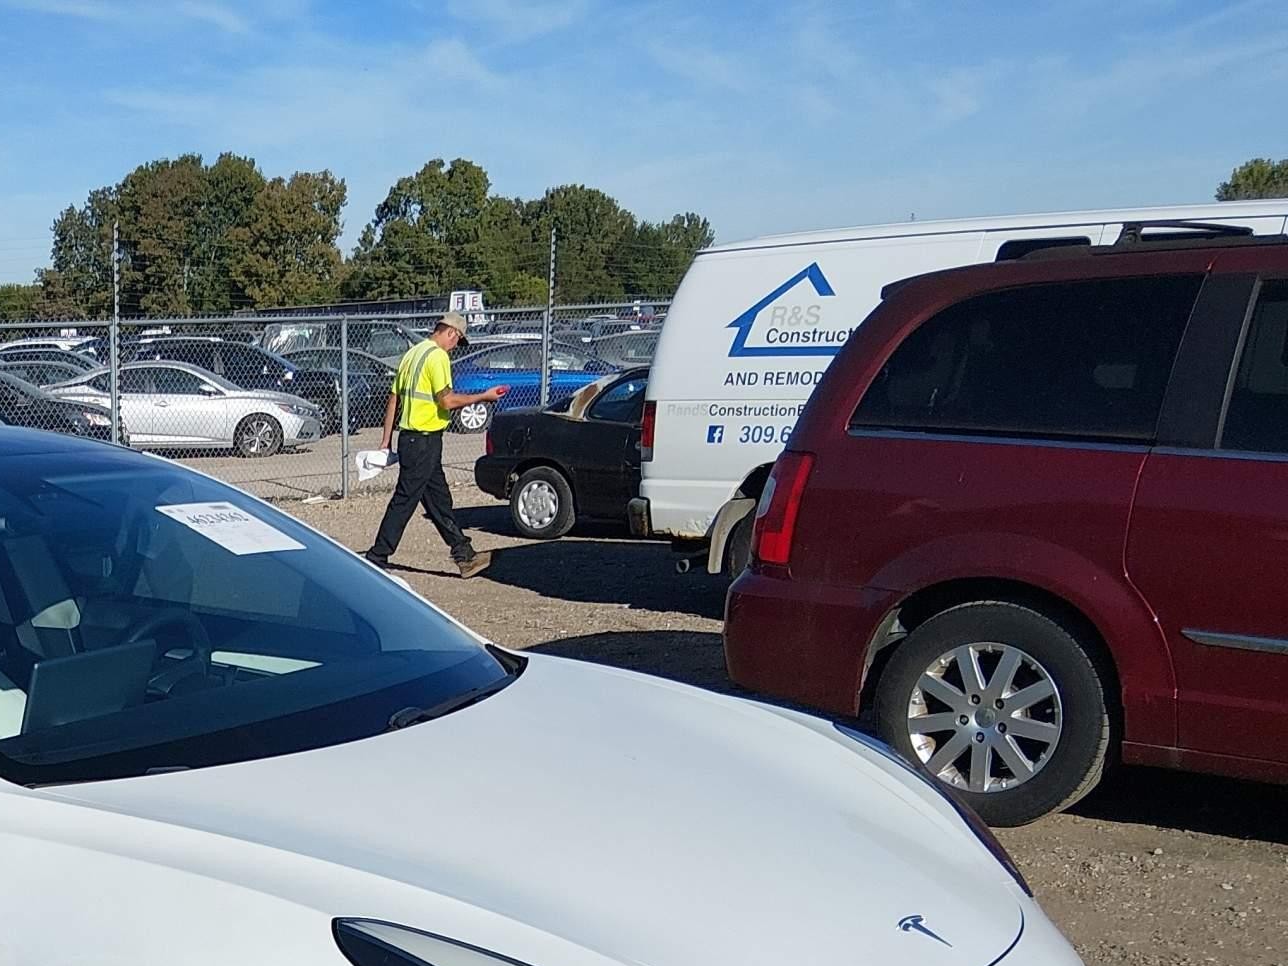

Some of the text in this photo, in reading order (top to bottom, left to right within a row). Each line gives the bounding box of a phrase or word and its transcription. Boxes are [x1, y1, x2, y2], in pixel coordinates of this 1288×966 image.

[770, 304, 821, 327] R&S
[724, 371, 824, 386] AND REMOD
[739, 425, 793, 444] 309.6
